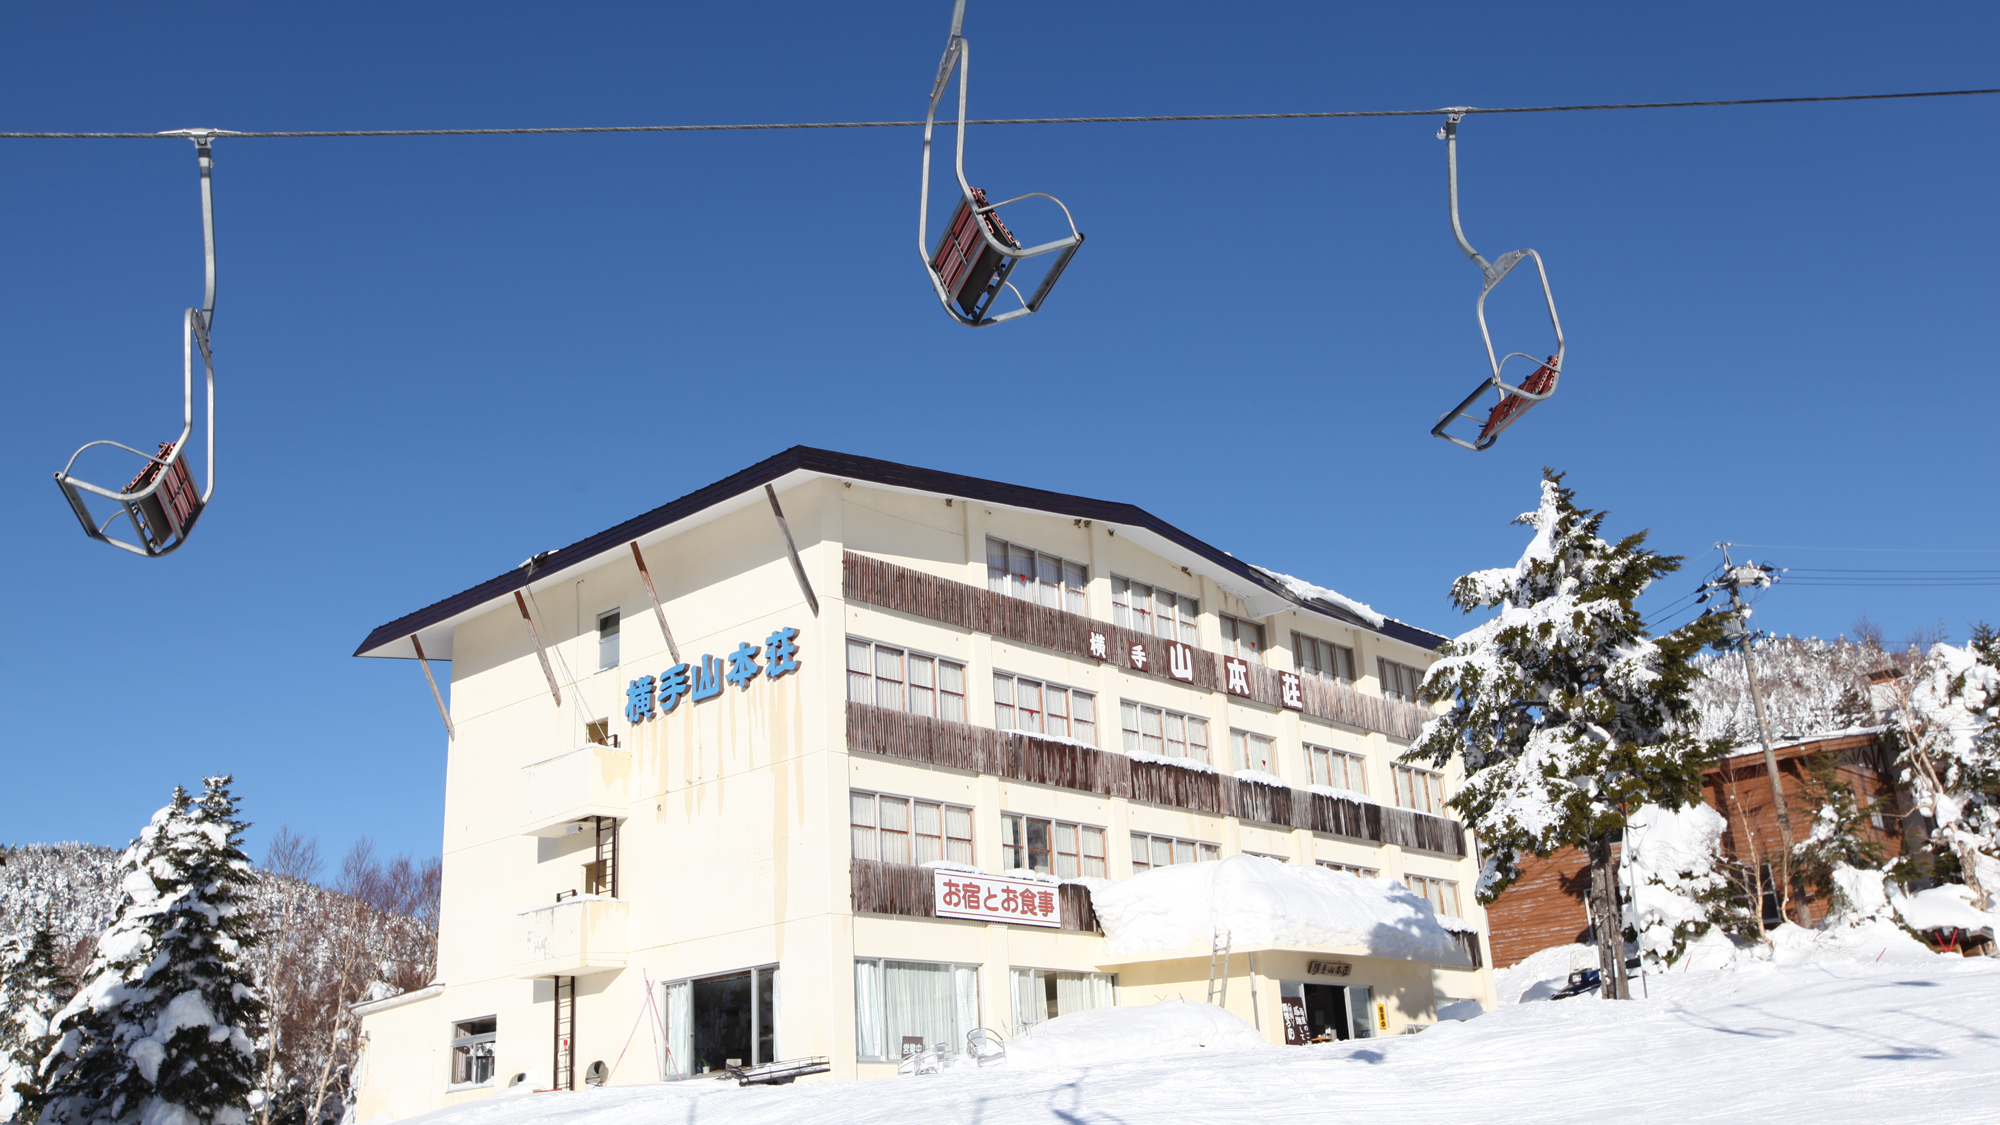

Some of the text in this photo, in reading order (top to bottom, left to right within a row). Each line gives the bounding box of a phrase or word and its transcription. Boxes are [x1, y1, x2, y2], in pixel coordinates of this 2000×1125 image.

[625, 627, 802, 724] 横手山本荘
[1090, 631, 1302, 708] 横手山本荘
[943, 878, 1055, 917] お宿とお食事
[903, 1043, 922, 1054] 営業中
